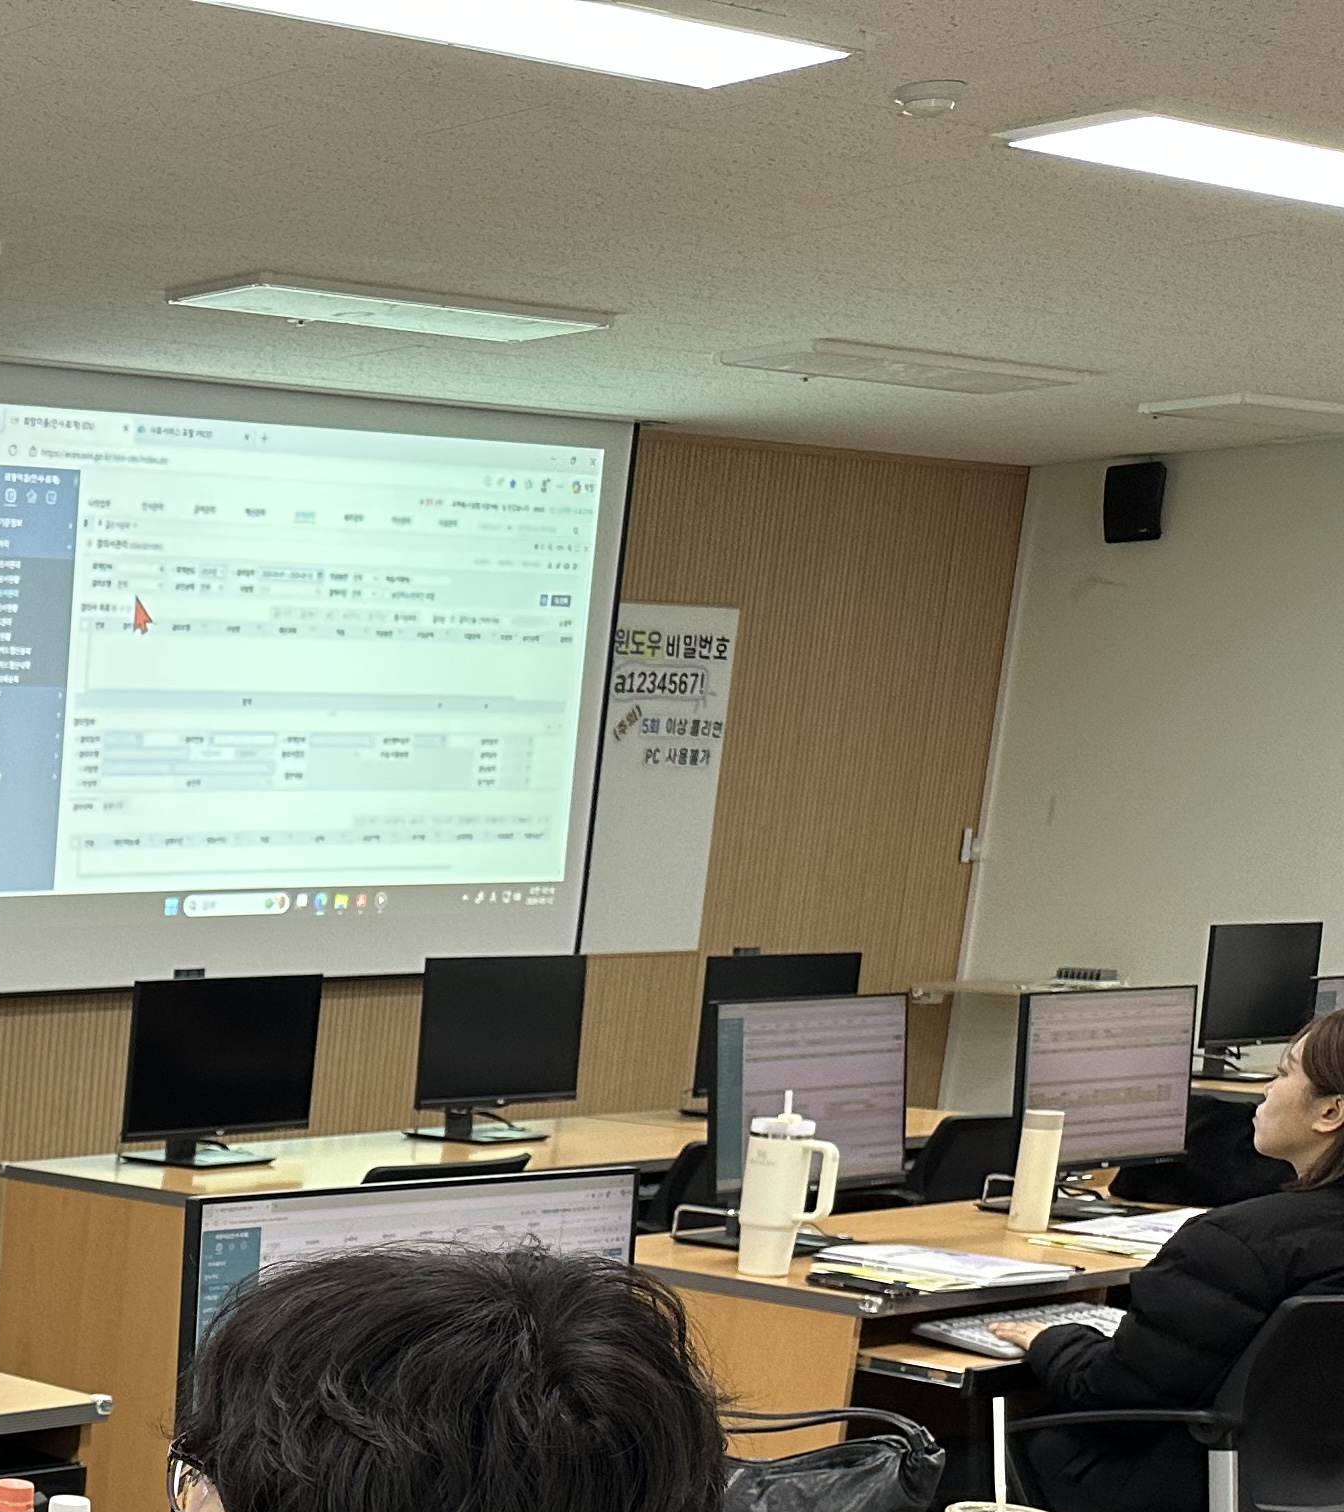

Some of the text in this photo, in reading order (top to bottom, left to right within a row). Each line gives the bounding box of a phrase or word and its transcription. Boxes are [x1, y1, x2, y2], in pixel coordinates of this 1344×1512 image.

[614, 628, 731, 661] 윈도우 비밀번호
[613, 671, 706, 695] a1234567!
[644, 747, 661, 765] PC
